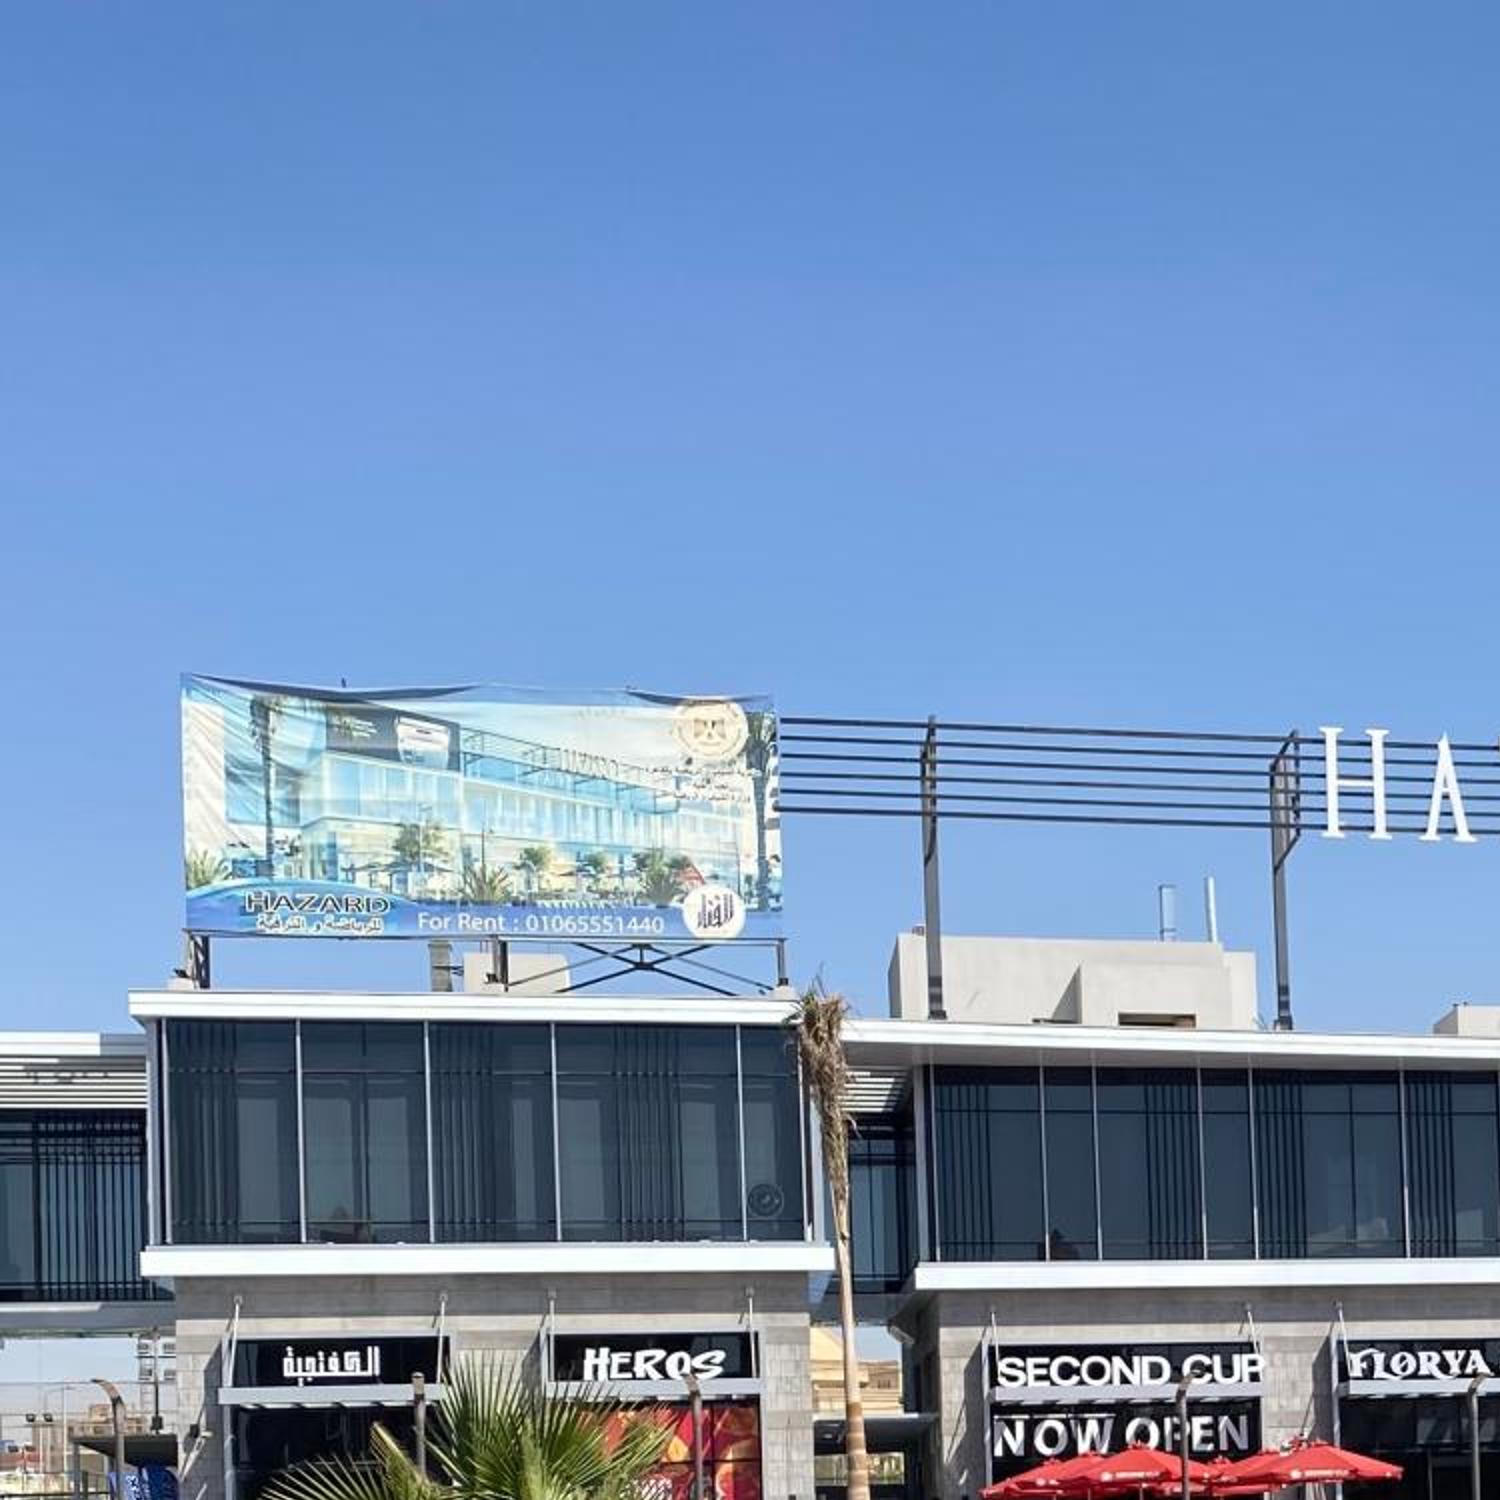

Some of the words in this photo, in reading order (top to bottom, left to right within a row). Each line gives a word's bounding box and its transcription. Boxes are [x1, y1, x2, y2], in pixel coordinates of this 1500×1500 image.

[245, 892, 390, 914] HAZARD
[418, 912, 453, 931] For
[458, 912, 504, 932] Rent
[526, 915, 665, 934] 01065551440
[583, 1346, 727, 1381] HEROS
[997, 1354, 1171, 1388] SECOND
[1182, 1353, 1265, 1384] CUP
[993, 1413, 1117, 1457] NOW
[1124, 1414, 1249, 1452] OPEN
